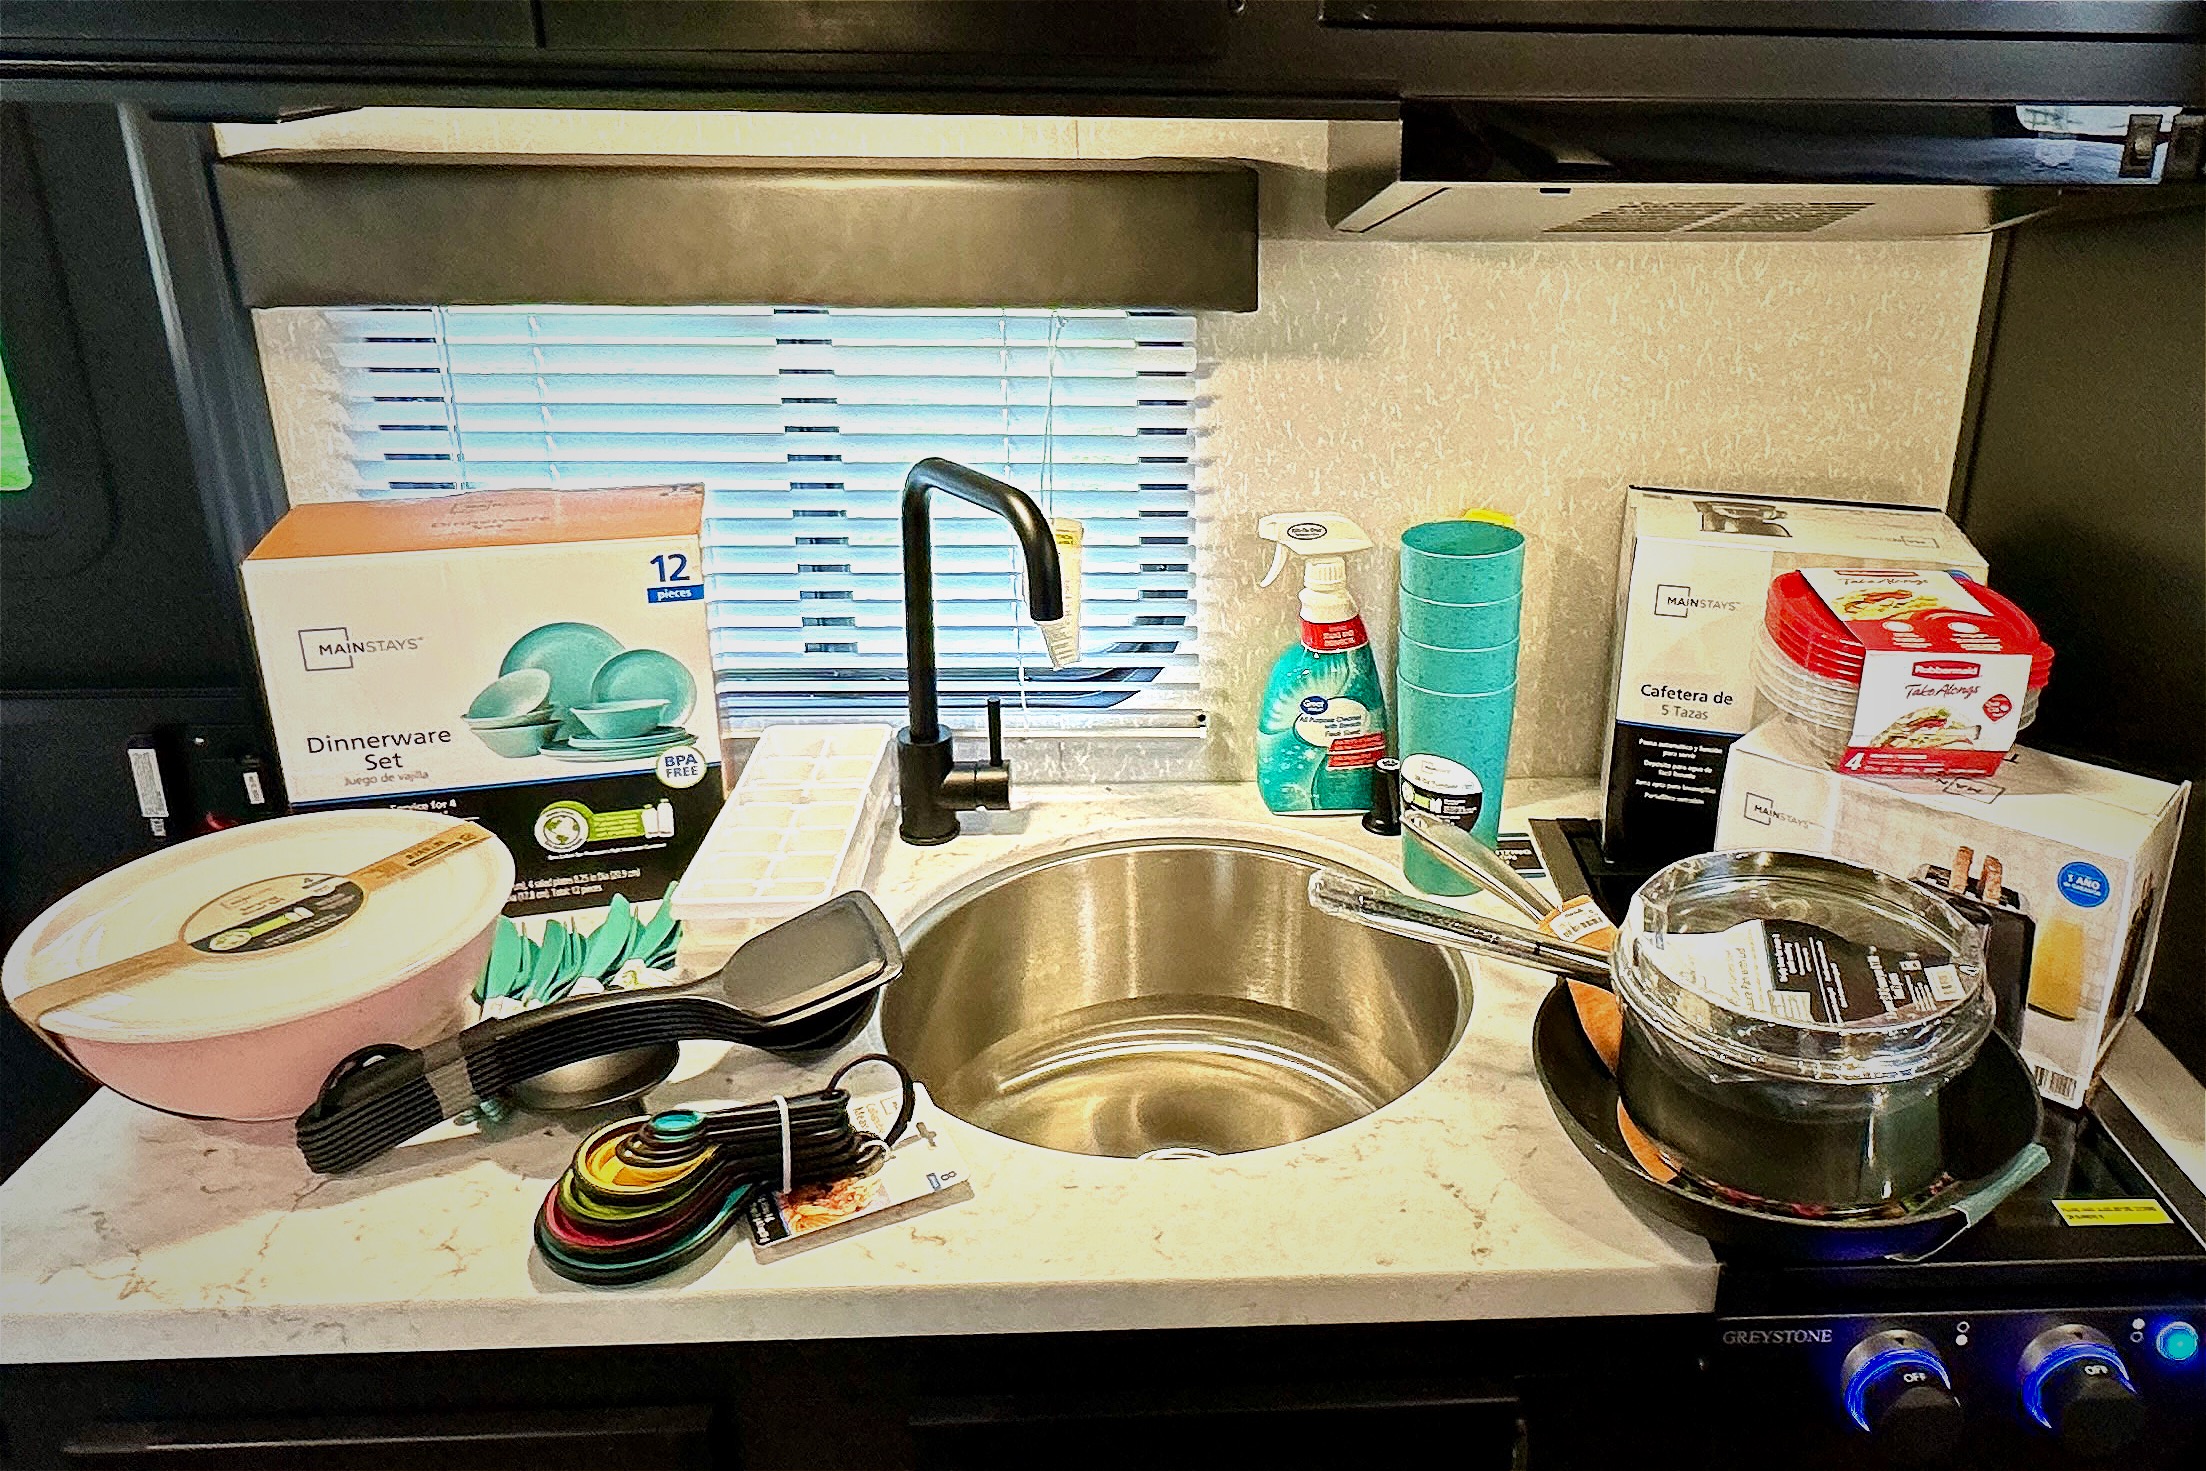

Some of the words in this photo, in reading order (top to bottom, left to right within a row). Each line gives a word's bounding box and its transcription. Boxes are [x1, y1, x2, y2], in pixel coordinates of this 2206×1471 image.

[650, 553, 690, 582] 12
[656, 588, 692, 602] pieces
[1667, 596, 1737, 612] MAINSTAYS
[319, 638, 419, 656] MAINSTAYS
[1641, 683, 1708, 703] Cafetera
[1713, 691, 1734, 705] de
[1661, 704, 1670, 716] 5
[1673, 705, 1709, 720] Tazas
[306, 729, 452, 754] Dinnerware
[364, 752, 404, 771] Set
[664, 753, 698, 768] BPA
[1845, 752, 1865, 771] 4
[380, 772, 395, 783] de
[665, 765, 698, 779] FREE
[1722, 1328, 1833, 1345] GREYSTONE
[1903, 1371, 1927, 1384] OFF
